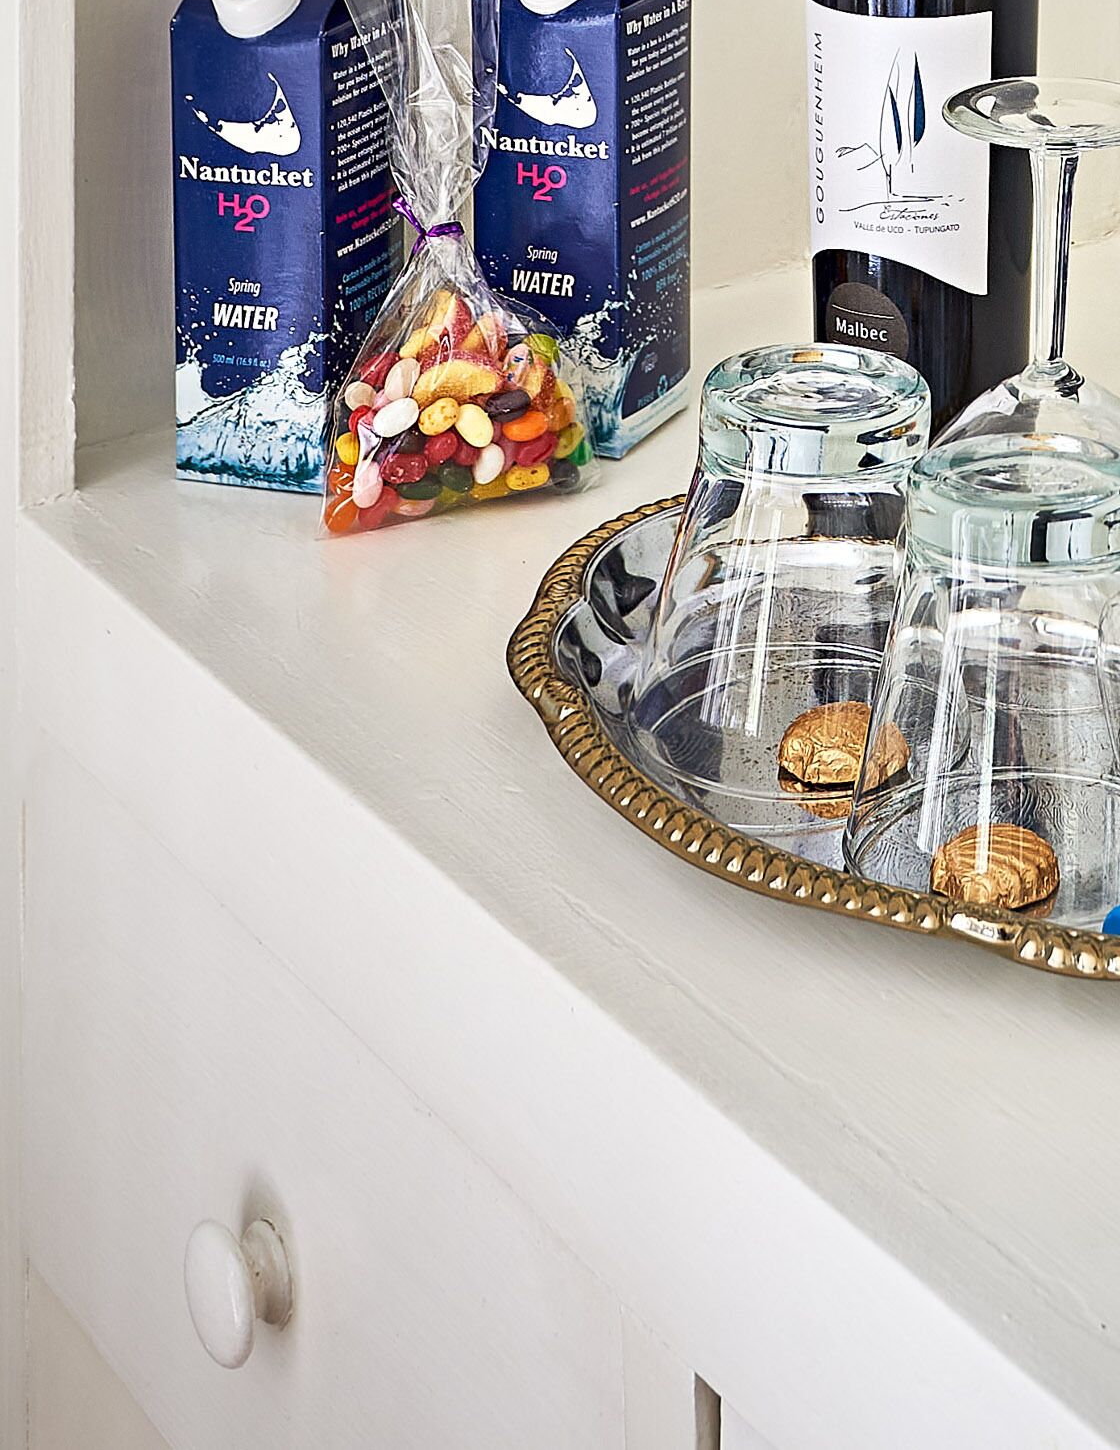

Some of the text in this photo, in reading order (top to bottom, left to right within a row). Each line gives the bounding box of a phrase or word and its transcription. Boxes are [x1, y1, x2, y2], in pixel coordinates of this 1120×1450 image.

[626, 20, 642, 35] Why
[643, 12, 662, 28] Water
[663, 6, 670, 18] in
[671, 2, 677, 15] A
[331, 42, 349, 58] Why
[350, 33, 371, 50] Water
[814, 32, 825, 224] GOUGUENHEIM
[479, 126, 609, 160] Nantucket
[179, 155, 314, 188] Nantucket
[854, 220, 874, 231] VALLE
[875, 225, 886, 233] de
[887, 225, 904, 234] UCO
[914, 223, 960, 234] TUPUNGATO
[527, 245, 558, 264] Spring
[228, 277, 261, 297] Spring
[512, 269, 575, 297] WATER
[213, 302, 279, 331] WATER
[835, 316, 888, 342] Malbec
[212, 354, 225, 363] 500
[226, 355, 235, 364] ml
